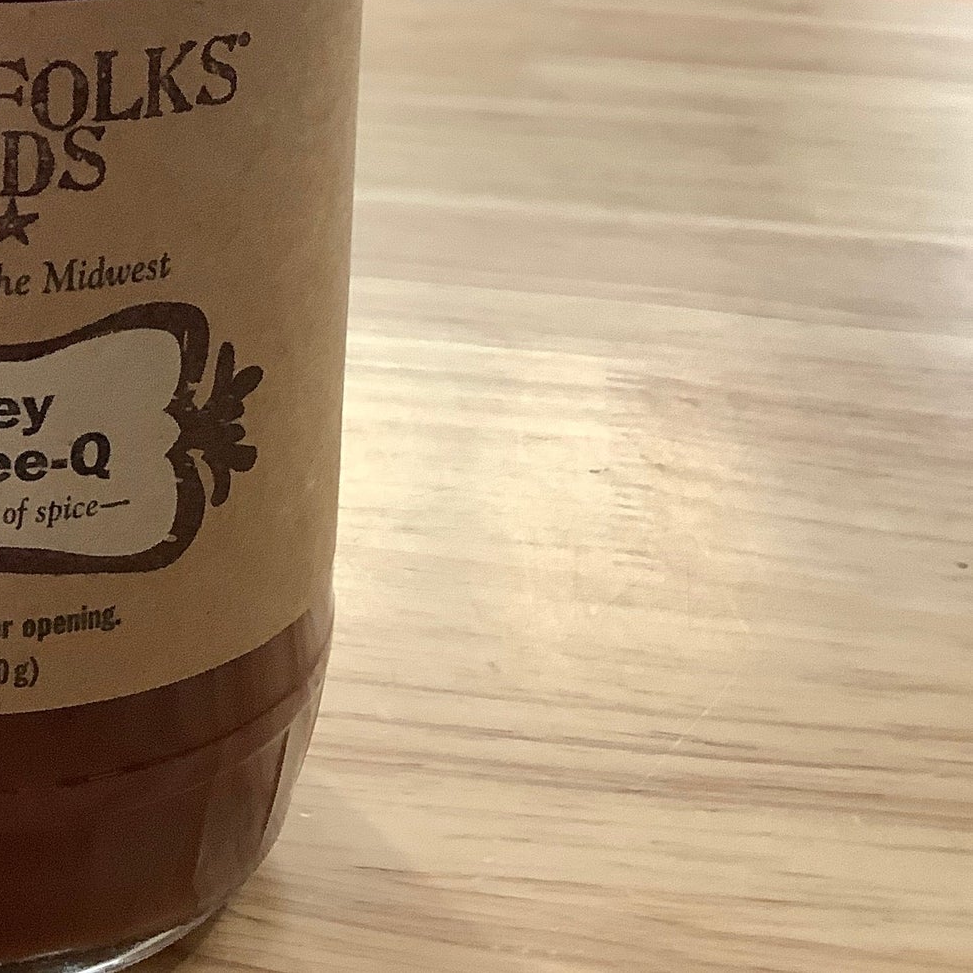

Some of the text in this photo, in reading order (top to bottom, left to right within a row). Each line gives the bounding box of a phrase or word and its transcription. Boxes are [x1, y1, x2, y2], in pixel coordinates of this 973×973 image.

[42, 252, 171, 294] Midwest
[2, 497, 30, 530] of
[22, 604, 122, 642] opening.
